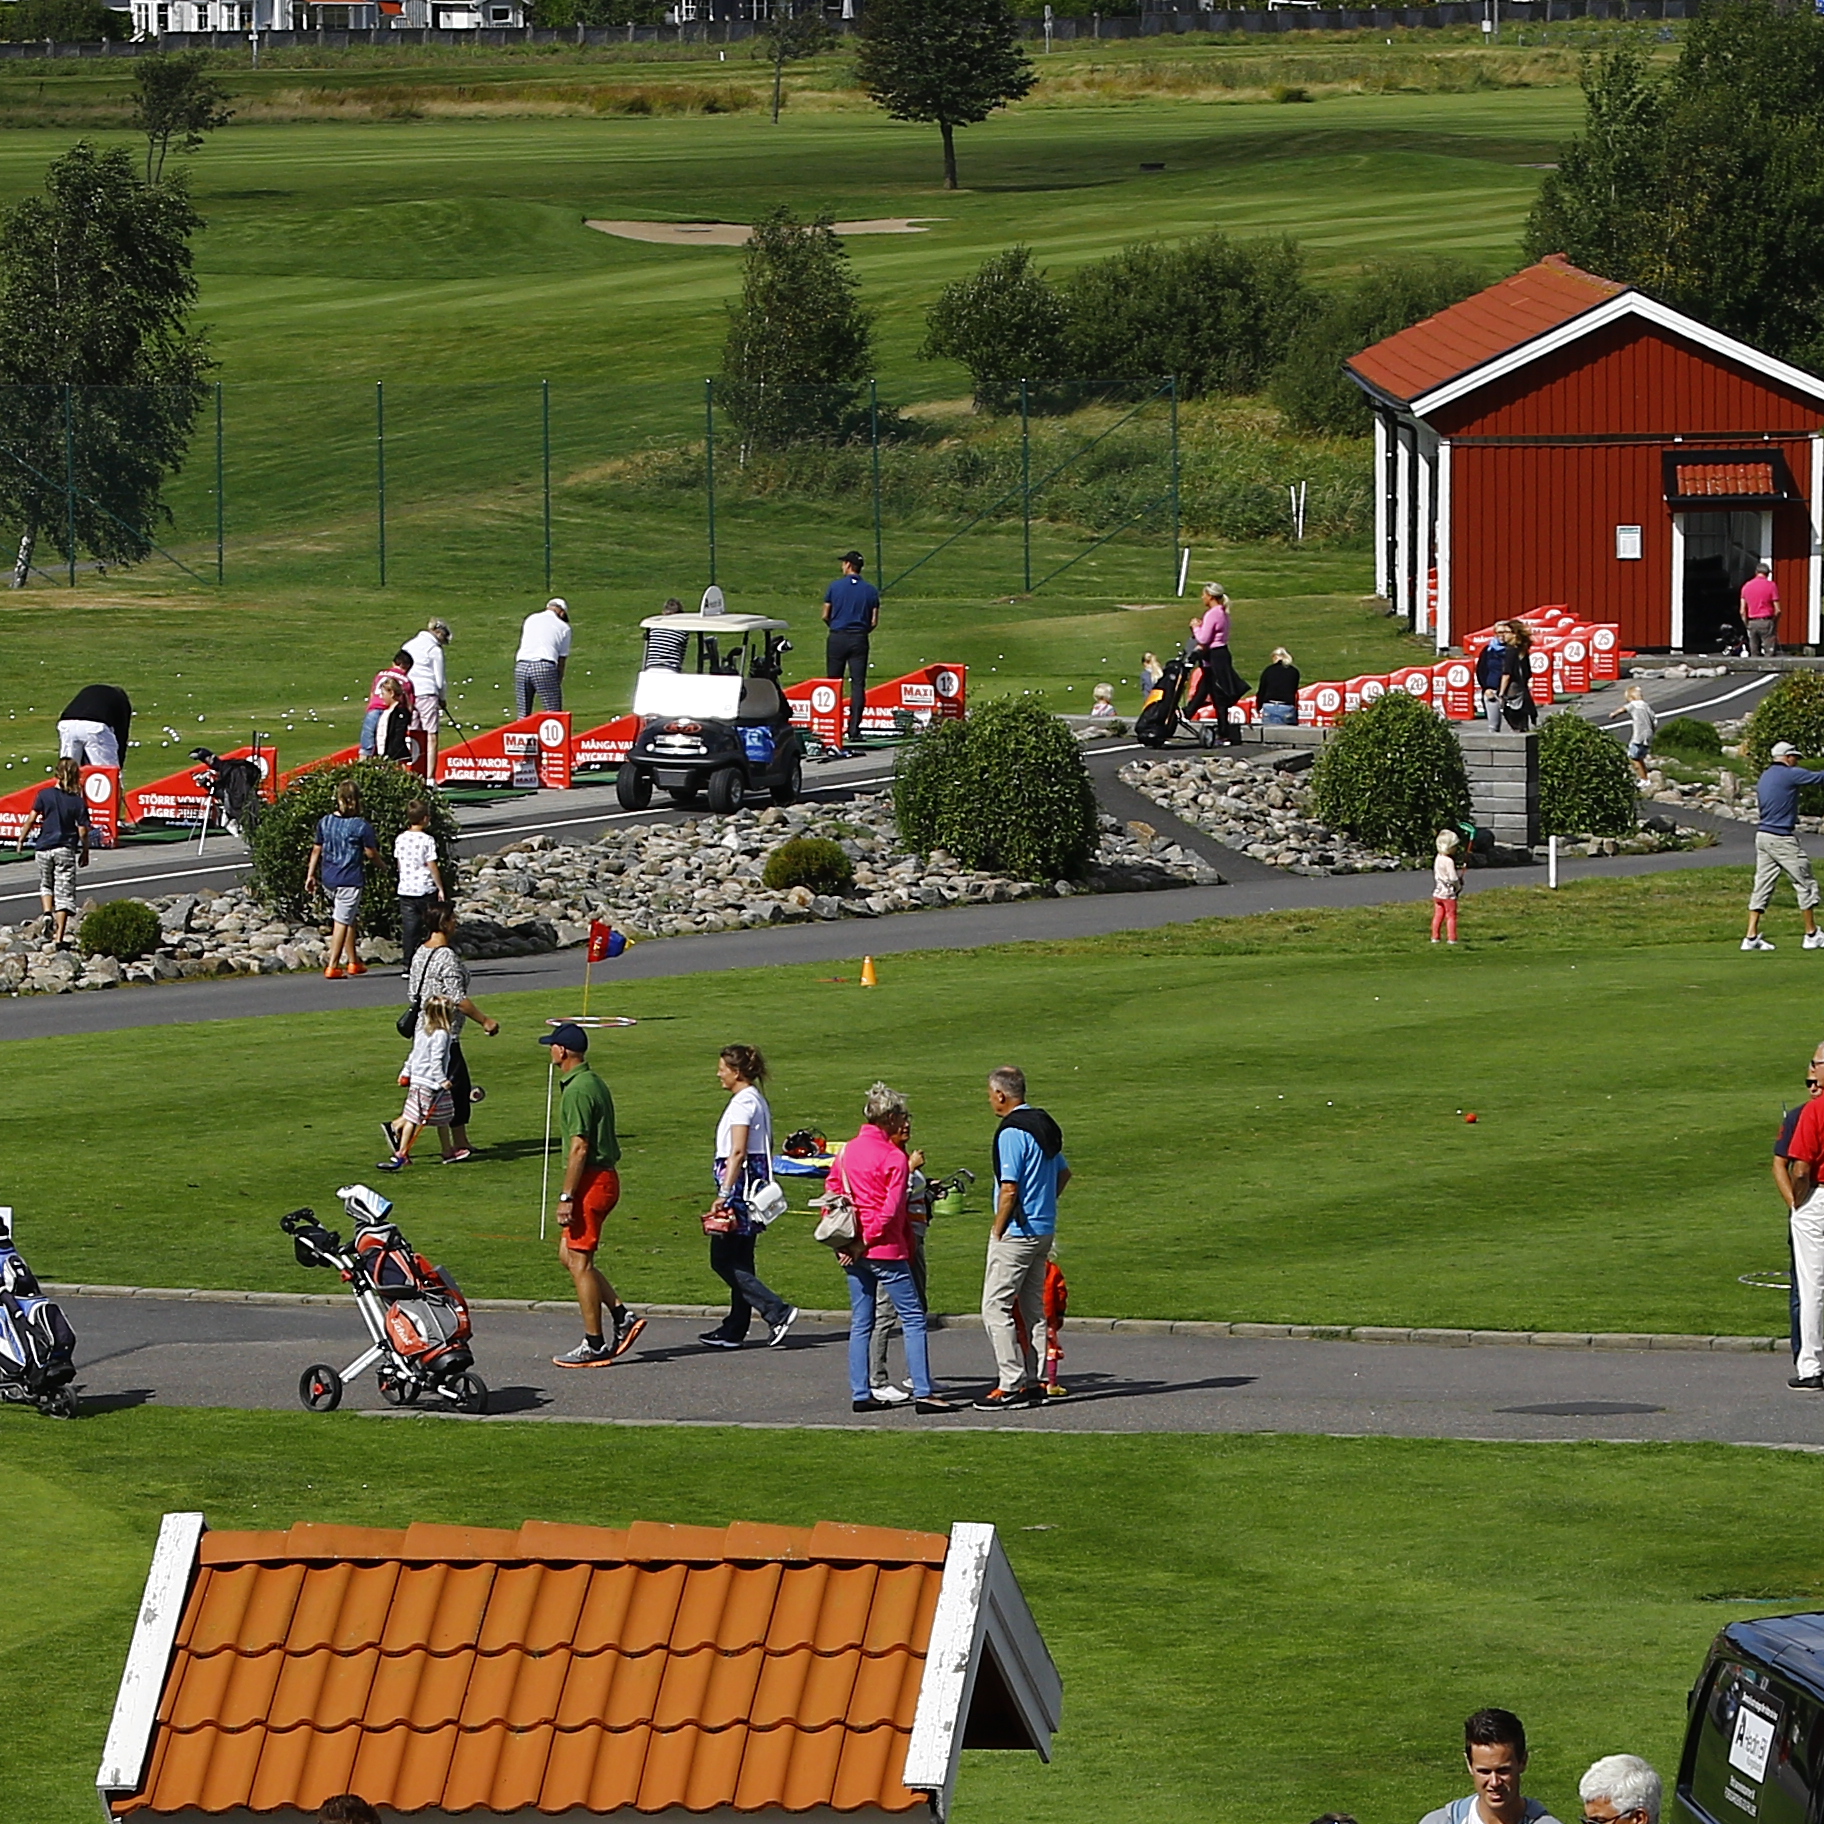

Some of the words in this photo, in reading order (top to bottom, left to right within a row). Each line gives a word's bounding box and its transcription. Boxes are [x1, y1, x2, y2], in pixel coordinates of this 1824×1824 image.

[903, 686, 933, 697] MAXI
[817, 691, 831, 707] 12
[1321, 692, 1335, 707] 18
[791, 703, 809, 713] AXI
[544, 724, 559, 742] 10
[506, 735, 537, 747] MAXI
[447, 757, 474, 768] EGNA
[93, 778, 102, 798] 7
[138, 793, 176, 806] STÖRRE
